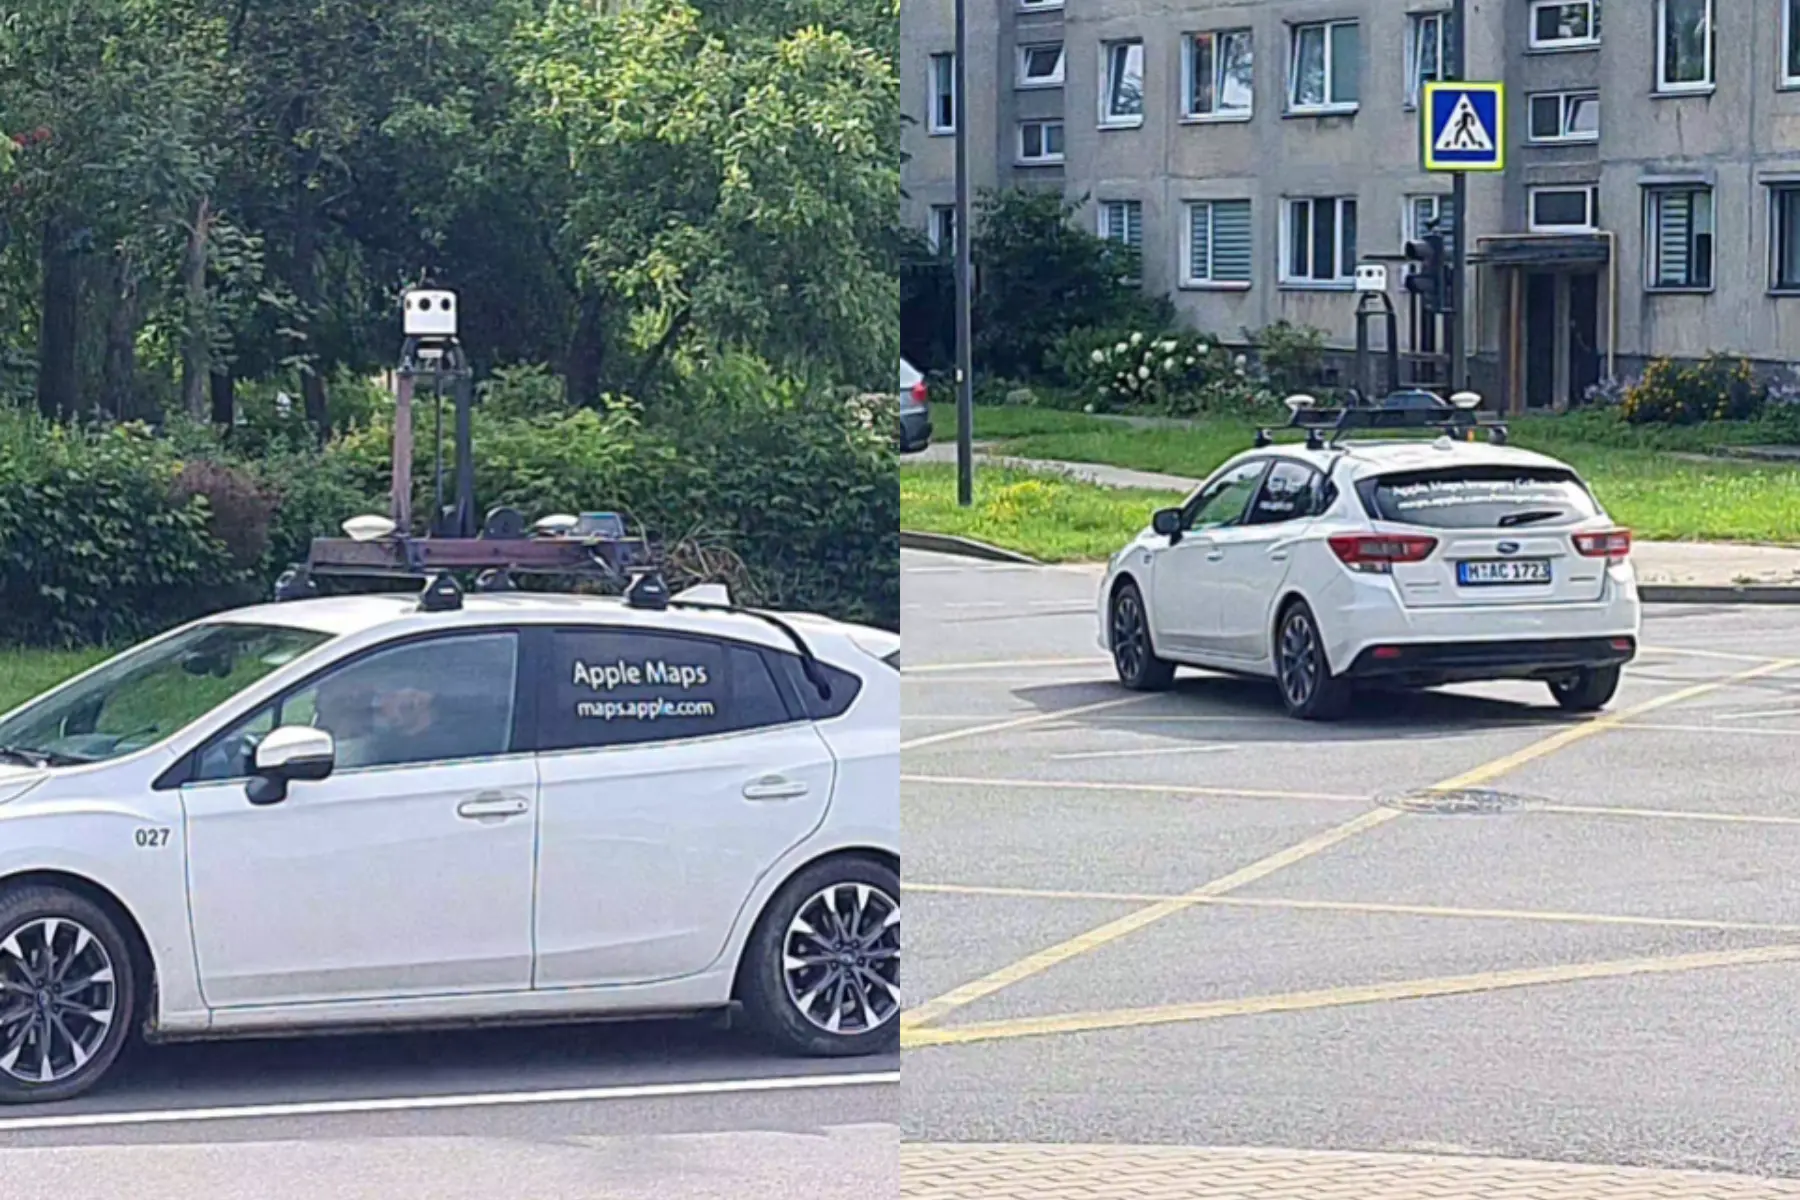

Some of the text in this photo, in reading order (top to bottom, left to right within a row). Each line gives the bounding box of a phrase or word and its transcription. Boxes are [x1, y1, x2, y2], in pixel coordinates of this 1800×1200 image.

[573, 659, 708, 691] Apple Maps
[577, 697, 715, 721] maps.apple.com
[135, 828, 171, 847] 027
